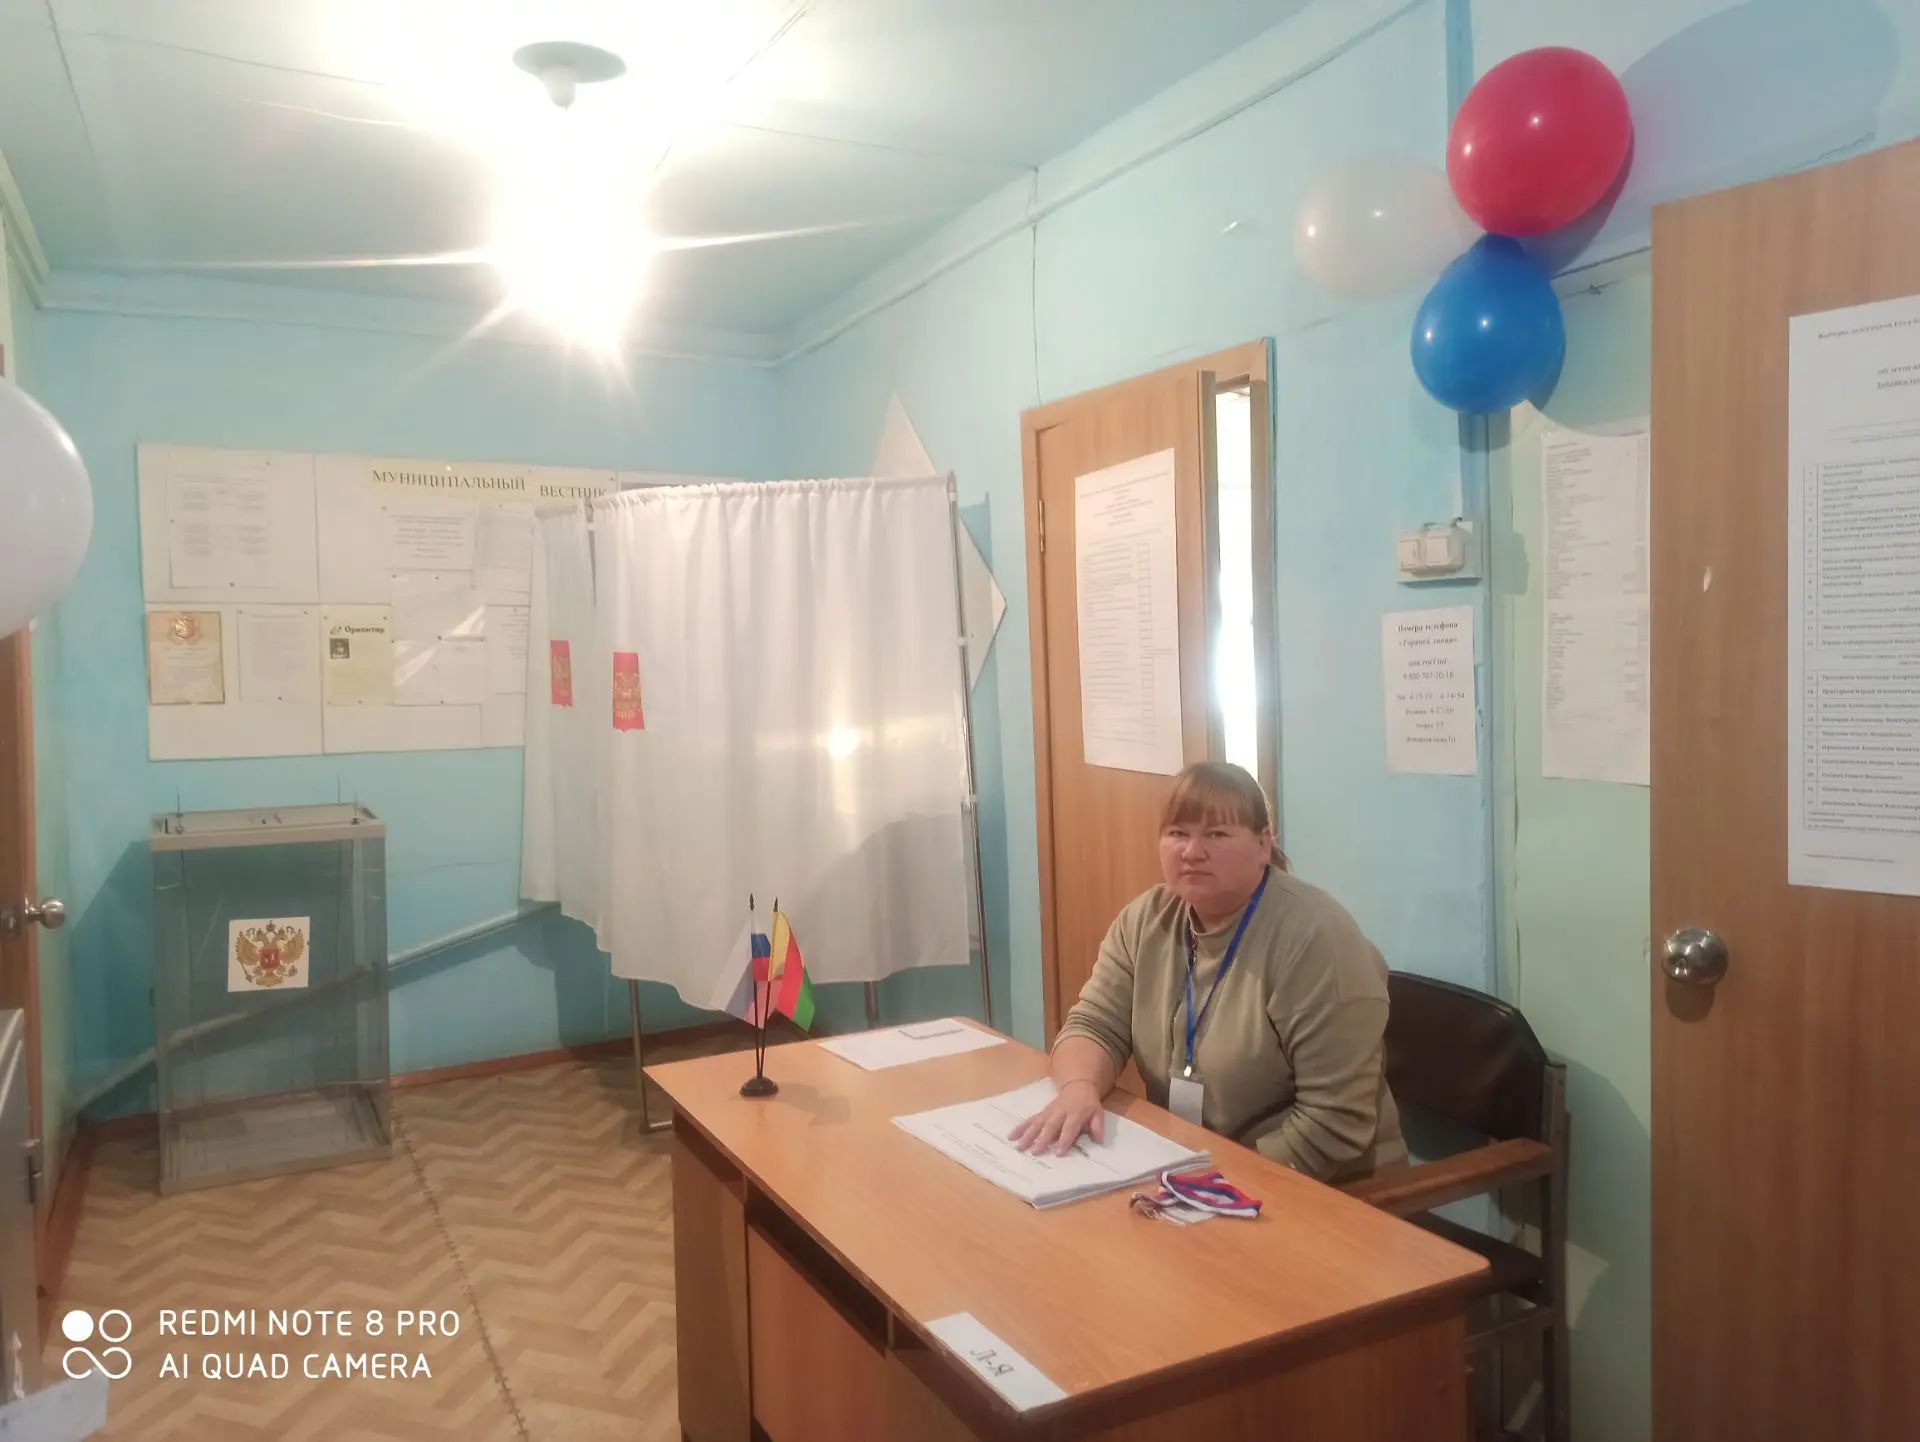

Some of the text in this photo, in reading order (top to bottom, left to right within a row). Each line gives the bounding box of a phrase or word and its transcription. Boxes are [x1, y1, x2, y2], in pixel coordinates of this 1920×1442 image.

[373, 470, 525, 491] МУНИЦИПАЛЬНЫЙ
[344, 625, 386, 636] Ориентир
[970, 1348, 1014, 1377] Л-Я
